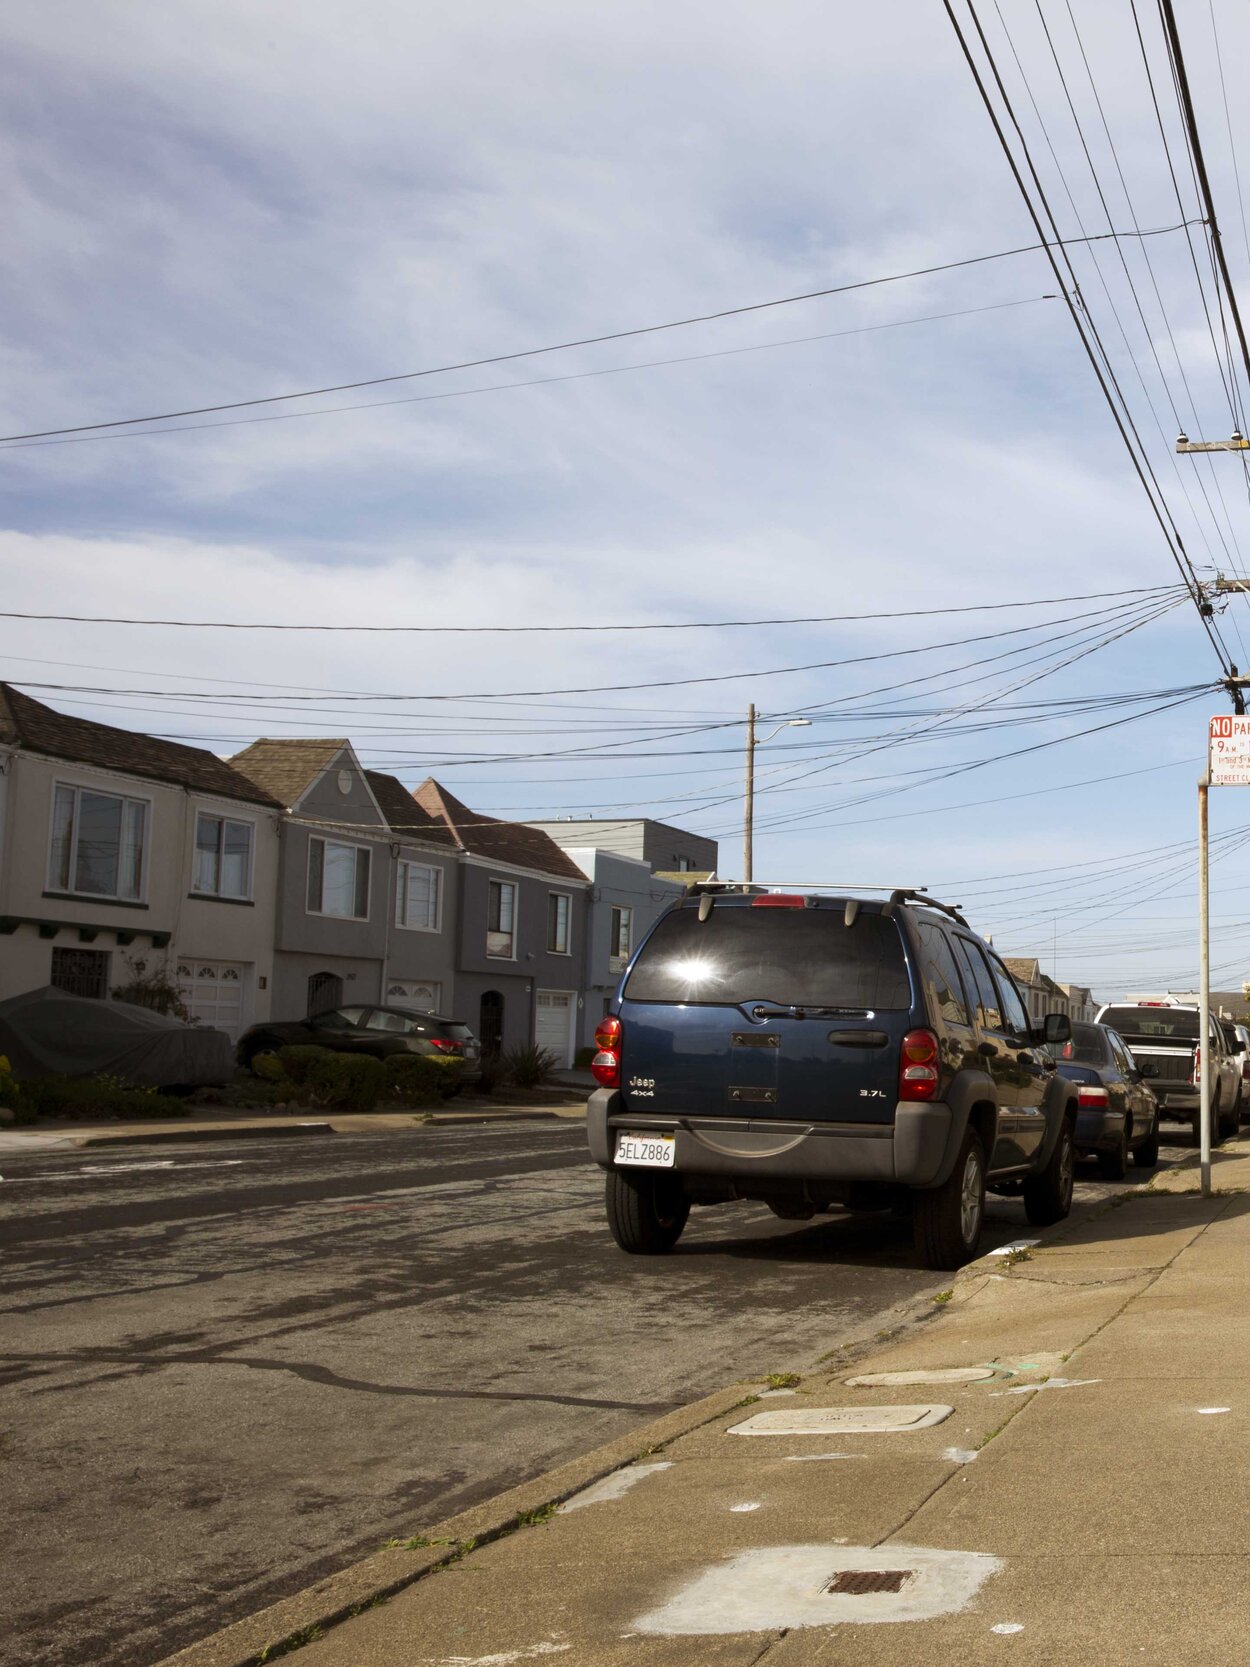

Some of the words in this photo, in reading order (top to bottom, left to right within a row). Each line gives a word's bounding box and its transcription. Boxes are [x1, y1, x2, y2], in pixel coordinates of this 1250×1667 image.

[1212, 719, 1231, 736] NO
[1217, 740, 1225, 753] 9
[1216, 774, 1240, 782] STREET
[629, 1076, 656, 1089] Jeep
[859, 1089, 887, 1098] 3.7L
[618, 1142, 671, 1161] 5ELZ886
